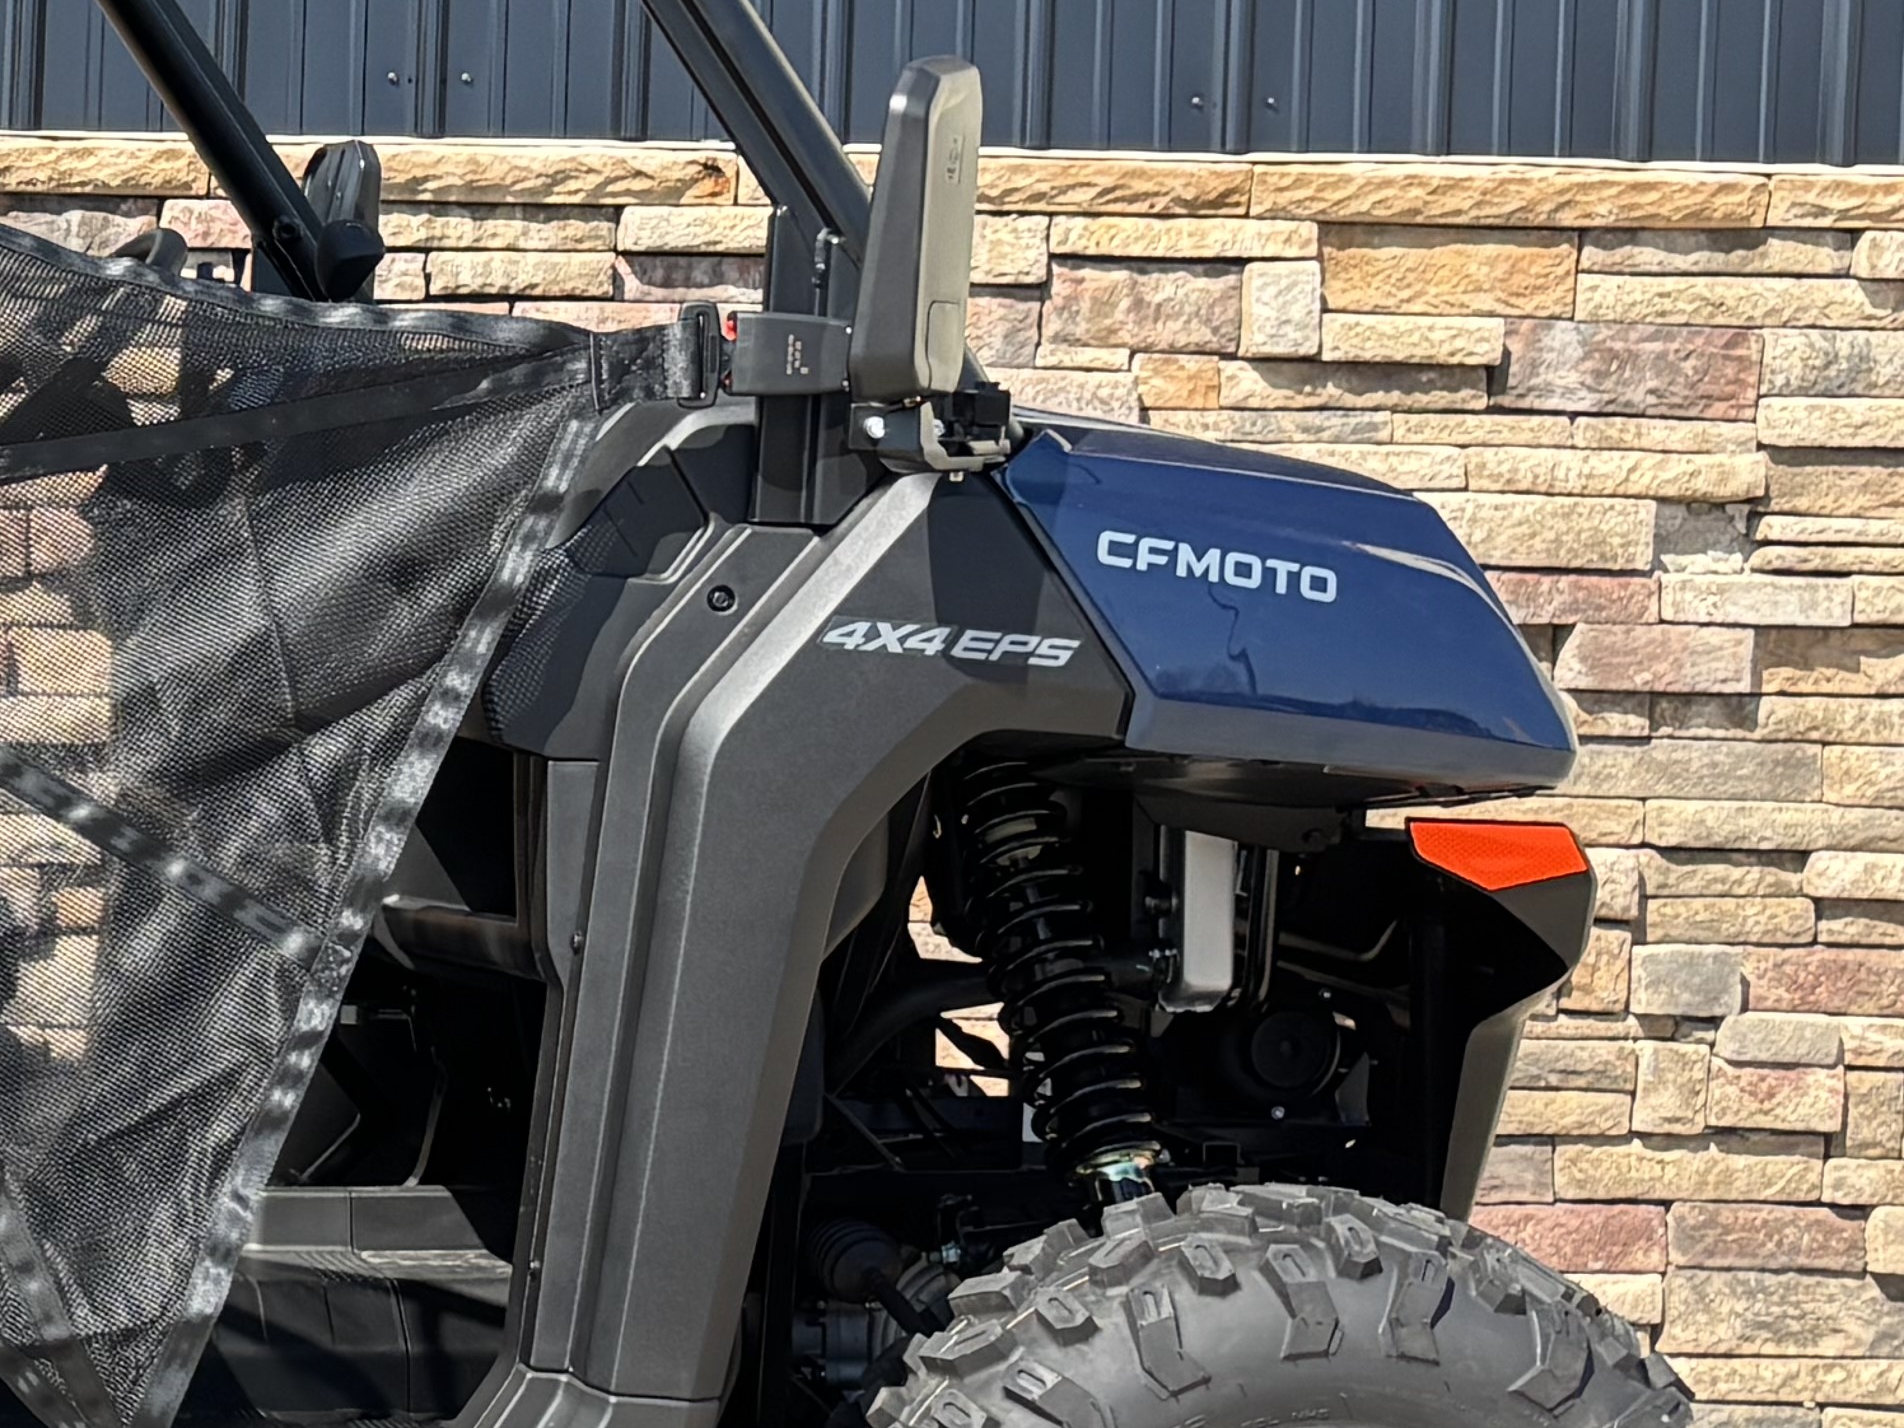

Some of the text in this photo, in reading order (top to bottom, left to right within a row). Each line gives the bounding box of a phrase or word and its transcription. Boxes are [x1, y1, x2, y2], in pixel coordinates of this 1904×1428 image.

[1096, 530, 1338, 603] CFMOTO
[821, 621, 1082, 668] 4X4 EPS
